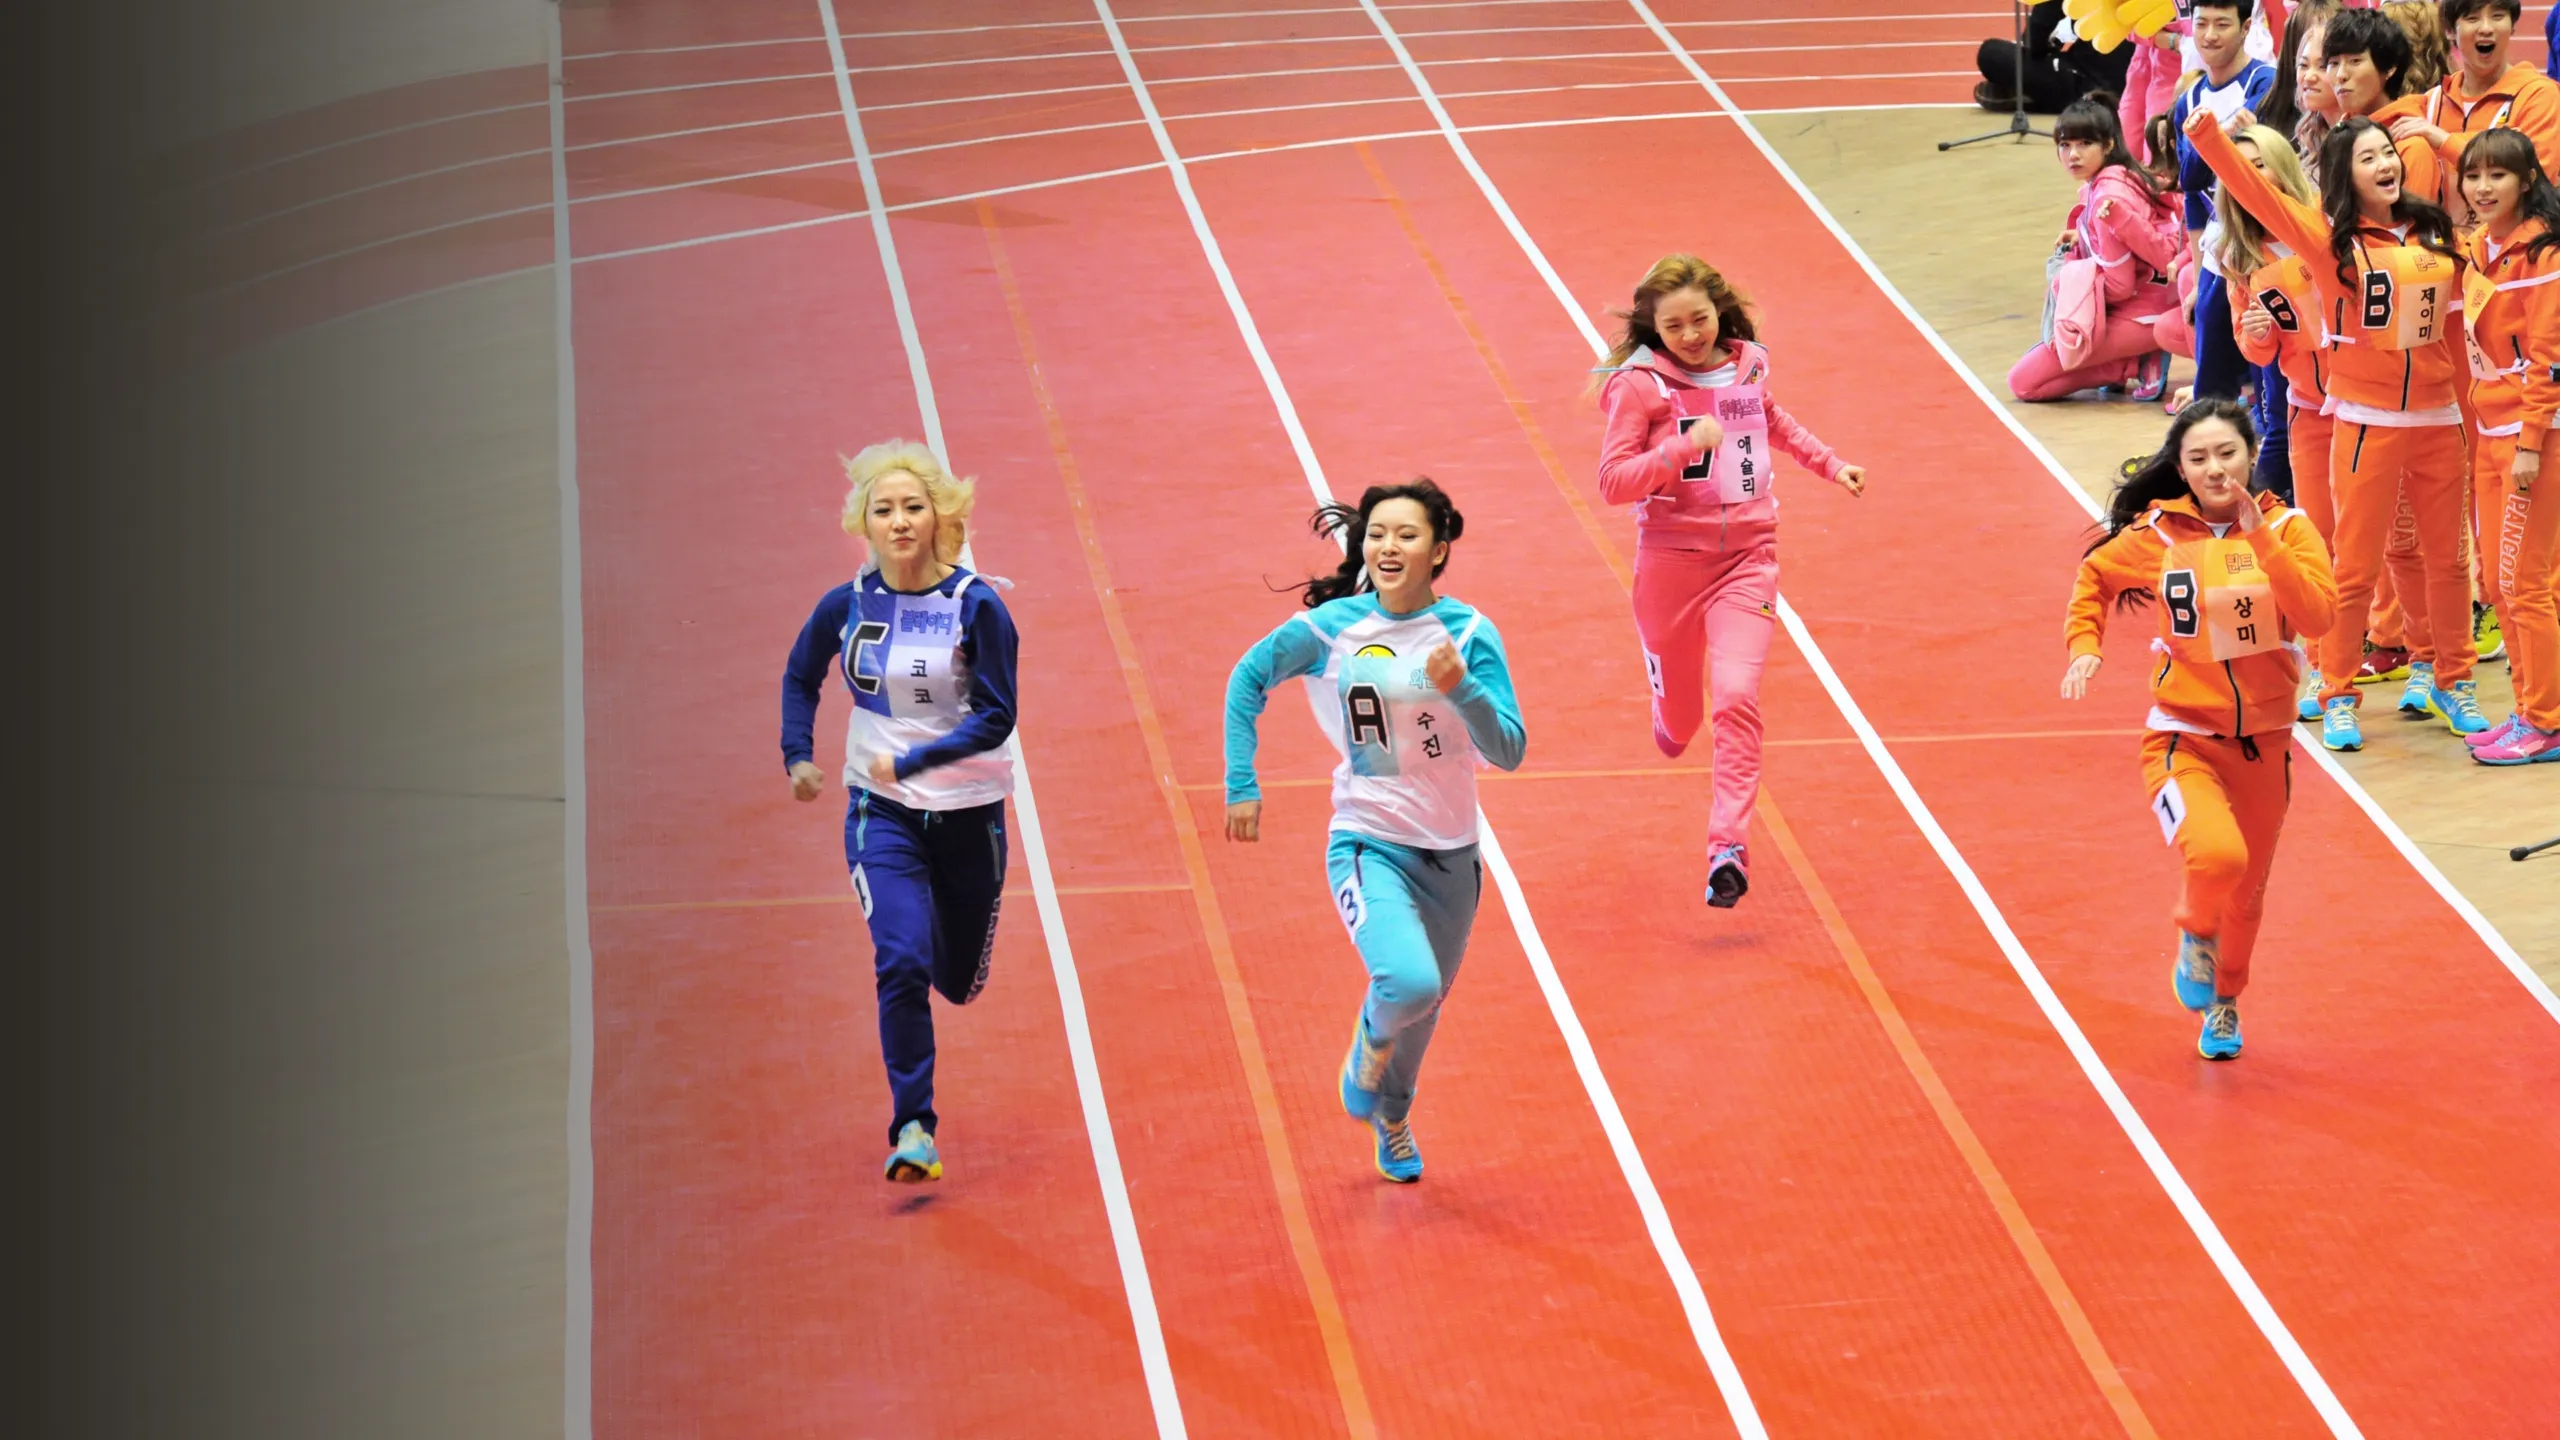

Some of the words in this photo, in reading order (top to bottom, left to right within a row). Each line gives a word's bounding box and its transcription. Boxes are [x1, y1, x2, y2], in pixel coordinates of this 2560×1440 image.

[2257, 286, 2300, 333] B
[2361, 270, 2394, 329] B
[2418, 287, 2436, 340] 제이미
[1738, 435, 1756, 496] 애슐리
[2163, 569, 2200, 637] B
[2234, 596, 2257, 645] 상미
[845, 621, 889, 695] C
[910, 659, 934, 704] 코코
[1347, 682, 1392, 755] A
[1417, 712, 1442, 759] 수진
[2162, 793, 2176, 824] 1
[1340, 888, 1358, 927] 3
